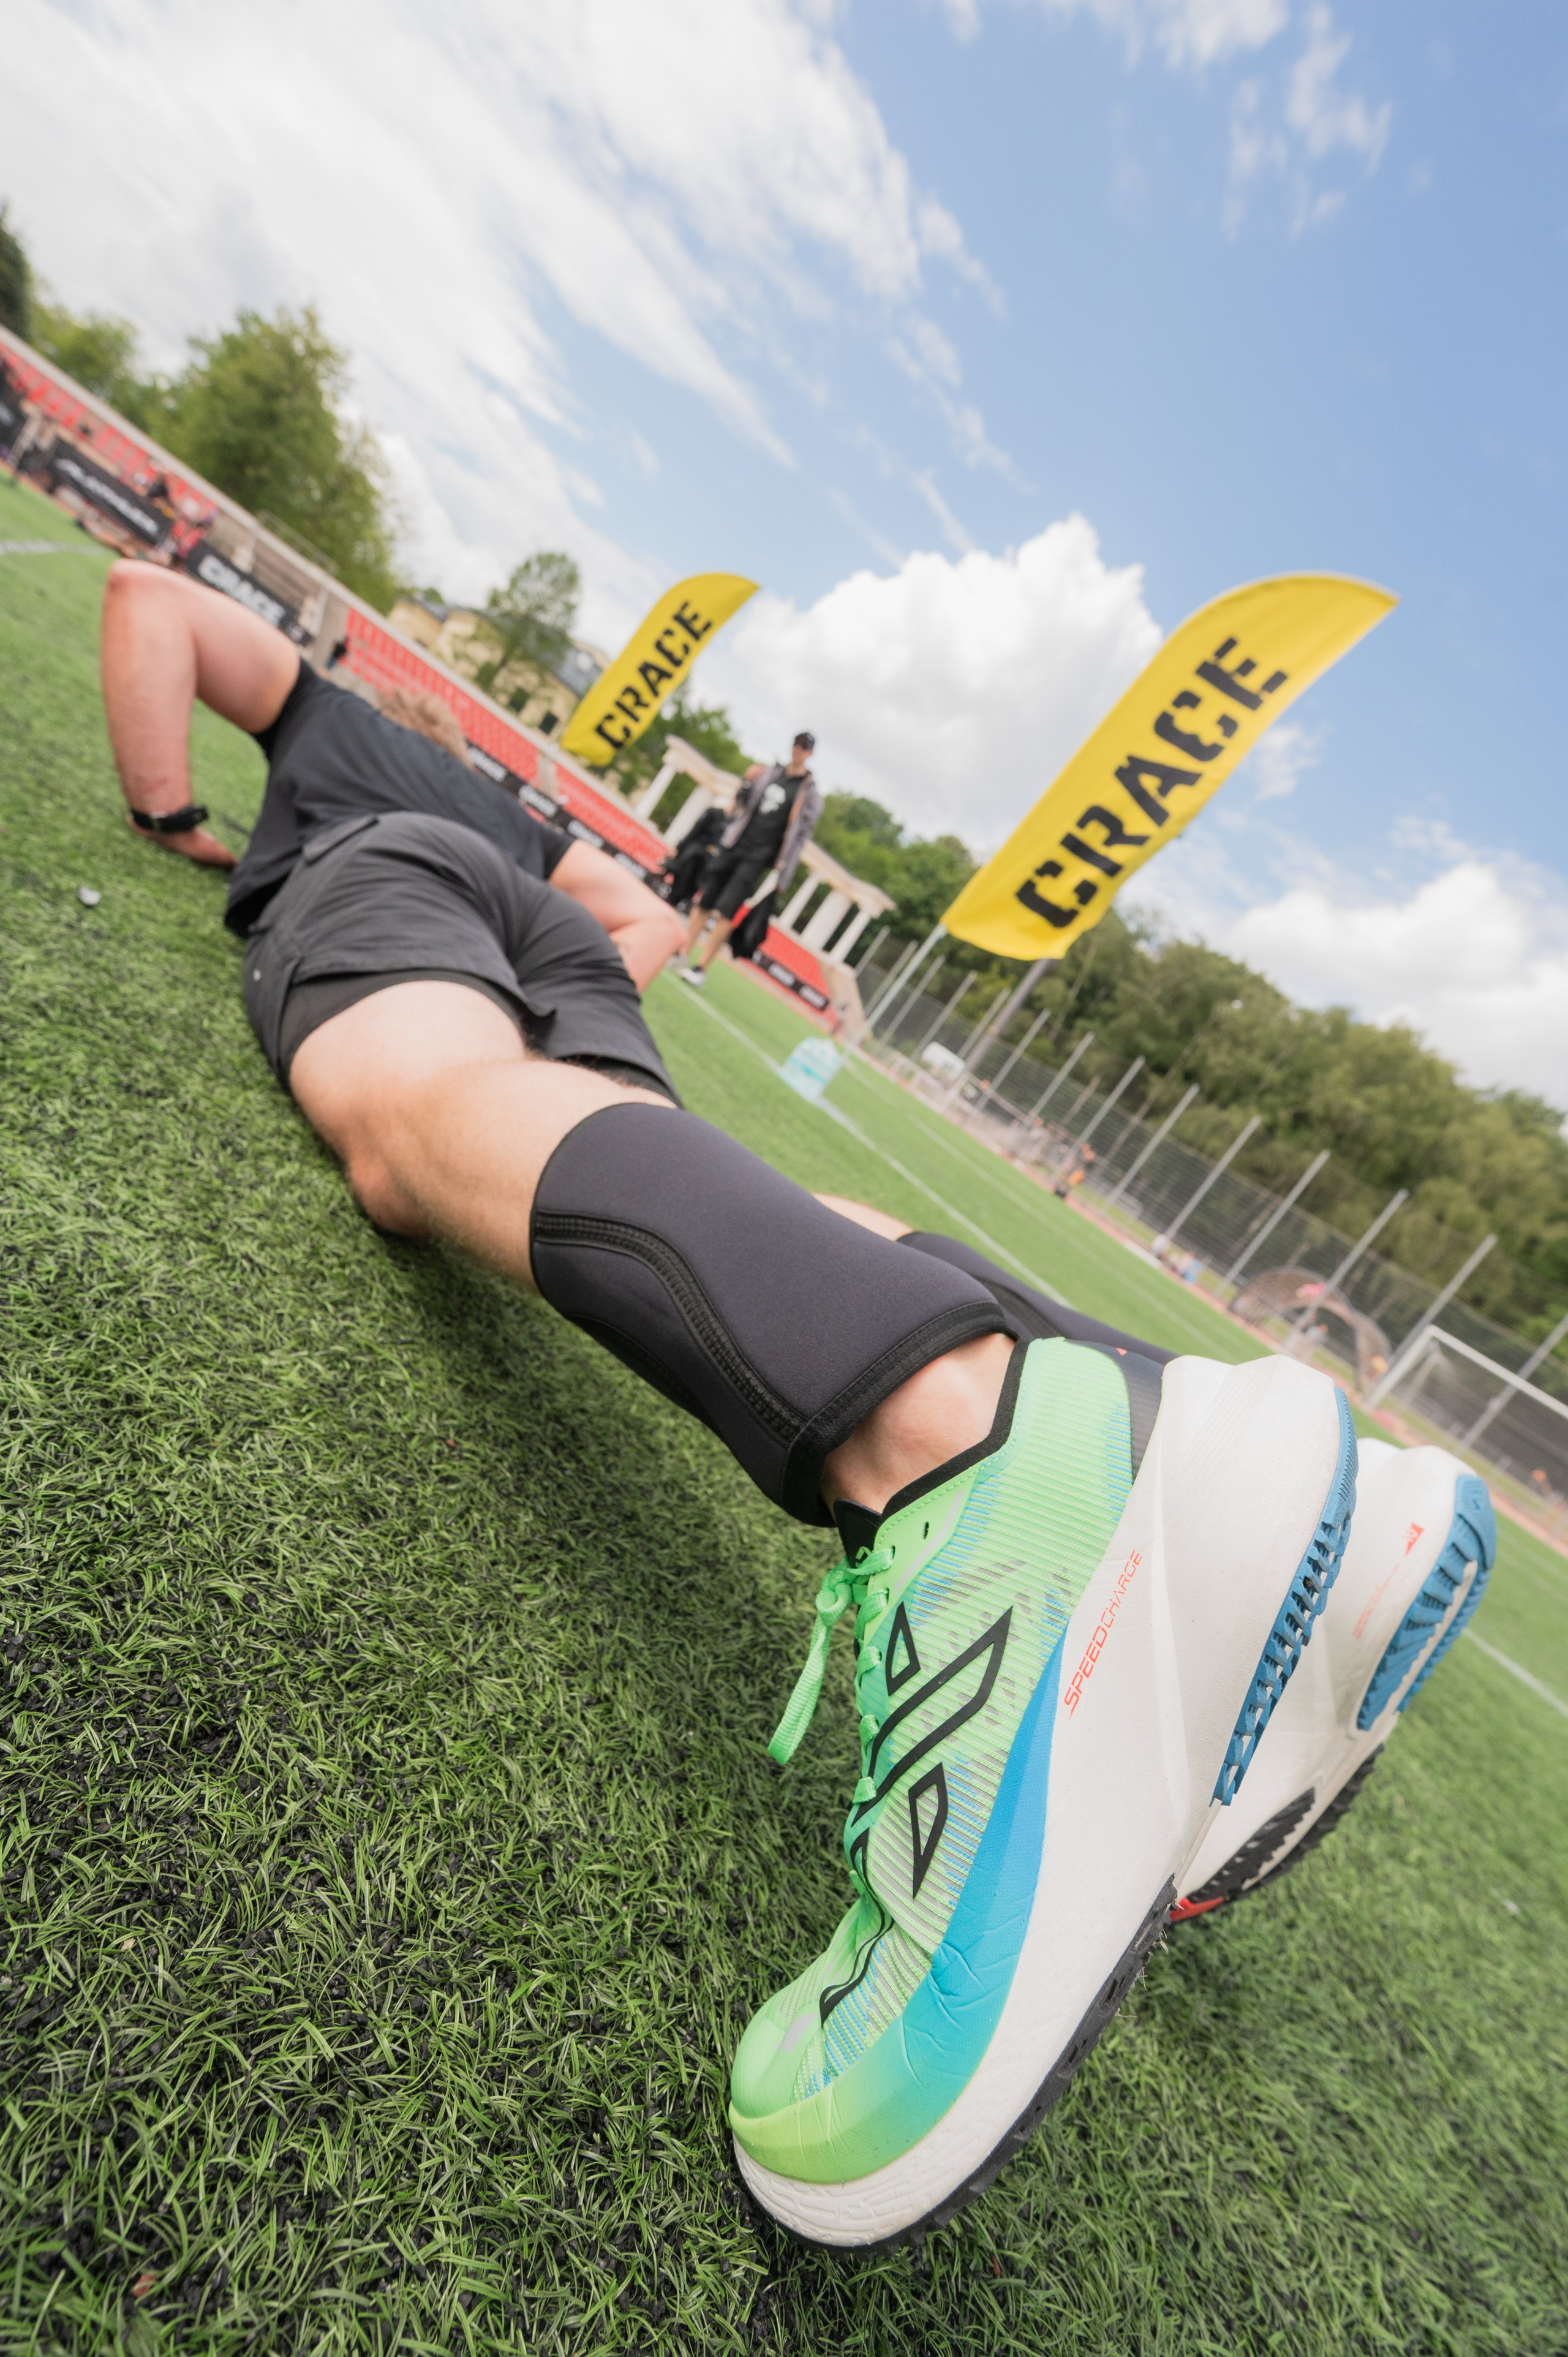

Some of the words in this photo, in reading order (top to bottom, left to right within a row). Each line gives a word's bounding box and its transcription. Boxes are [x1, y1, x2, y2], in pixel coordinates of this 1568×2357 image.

[595, 601, 713, 750] CRACE
[1014, 636, 1288, 929] CRACE
[1064, 1549, 1142, 1721] SPEEDCHARGE
